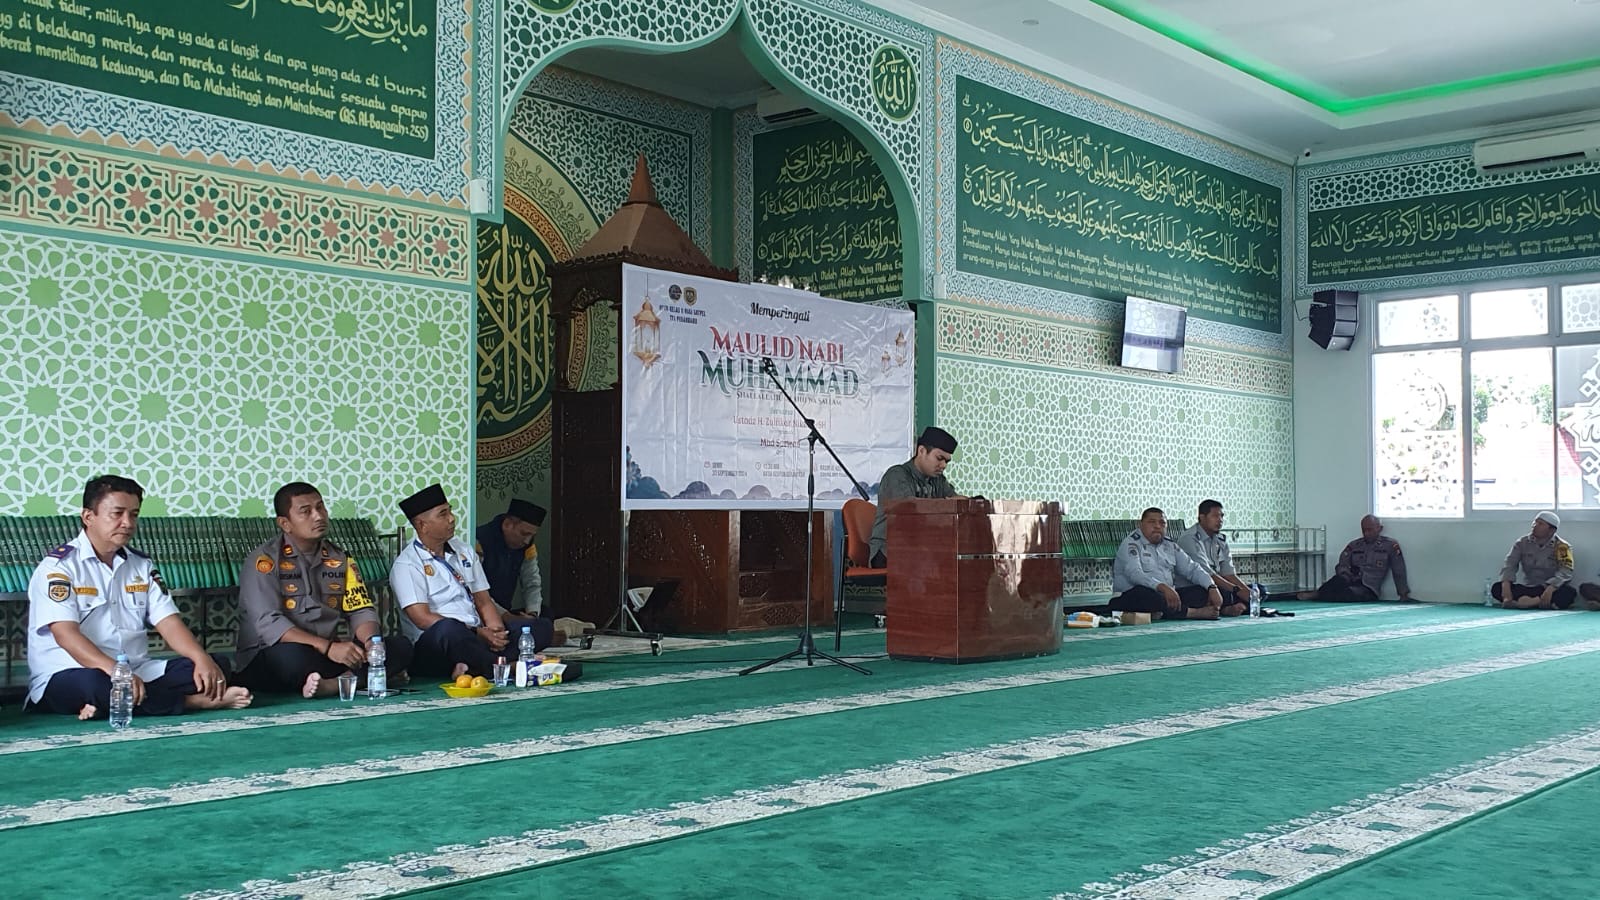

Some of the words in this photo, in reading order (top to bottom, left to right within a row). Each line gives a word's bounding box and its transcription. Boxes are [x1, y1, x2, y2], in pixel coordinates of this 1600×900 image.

[19, 11, 32, 30] di
[36, 14, 96, 48] belakang
[102, 36, 149, 58] mereka,
[152, 44, 175, 62] dan
[180, 55, 225, 75] mereka
[231, 62, 263, 82] tidak
[266, 74, 335, 99] mengetahui
[341, 93, 386, 110] sesuatu
[391, 104, 428, 123] apapun
[36, 45, 98, 68] memelihara
[160, 69, 180, 86] dan
[183, 72, 202, 90] Dia
[204, 78, 262, 107] Mahatinggi
[264, 93, 282, 109] dan
[283, 95, 336, 120] Mahabesar
[96, 8, 151, 35] milik-Nya
[155, 25, 175, 40] apa
[178, 30, 193, 46] yg
[195, 32, 215, 49] ada
[218, 38, 229, 51] di
[231, 40, 259, 60] langit
[264, 49, 283, 65] dan
[288, 58, 307, 71] apa
[312, 64, 338, 82] yang
[341, 69, 362, 84] ada
[366, 73, 380, 88] di
[384, 75, 427, 99] bumi
[709, 326, 794, 358] MAULID
[795, 335, 844, 364] NABI
[750, 302, 810, 324] Memperingati
